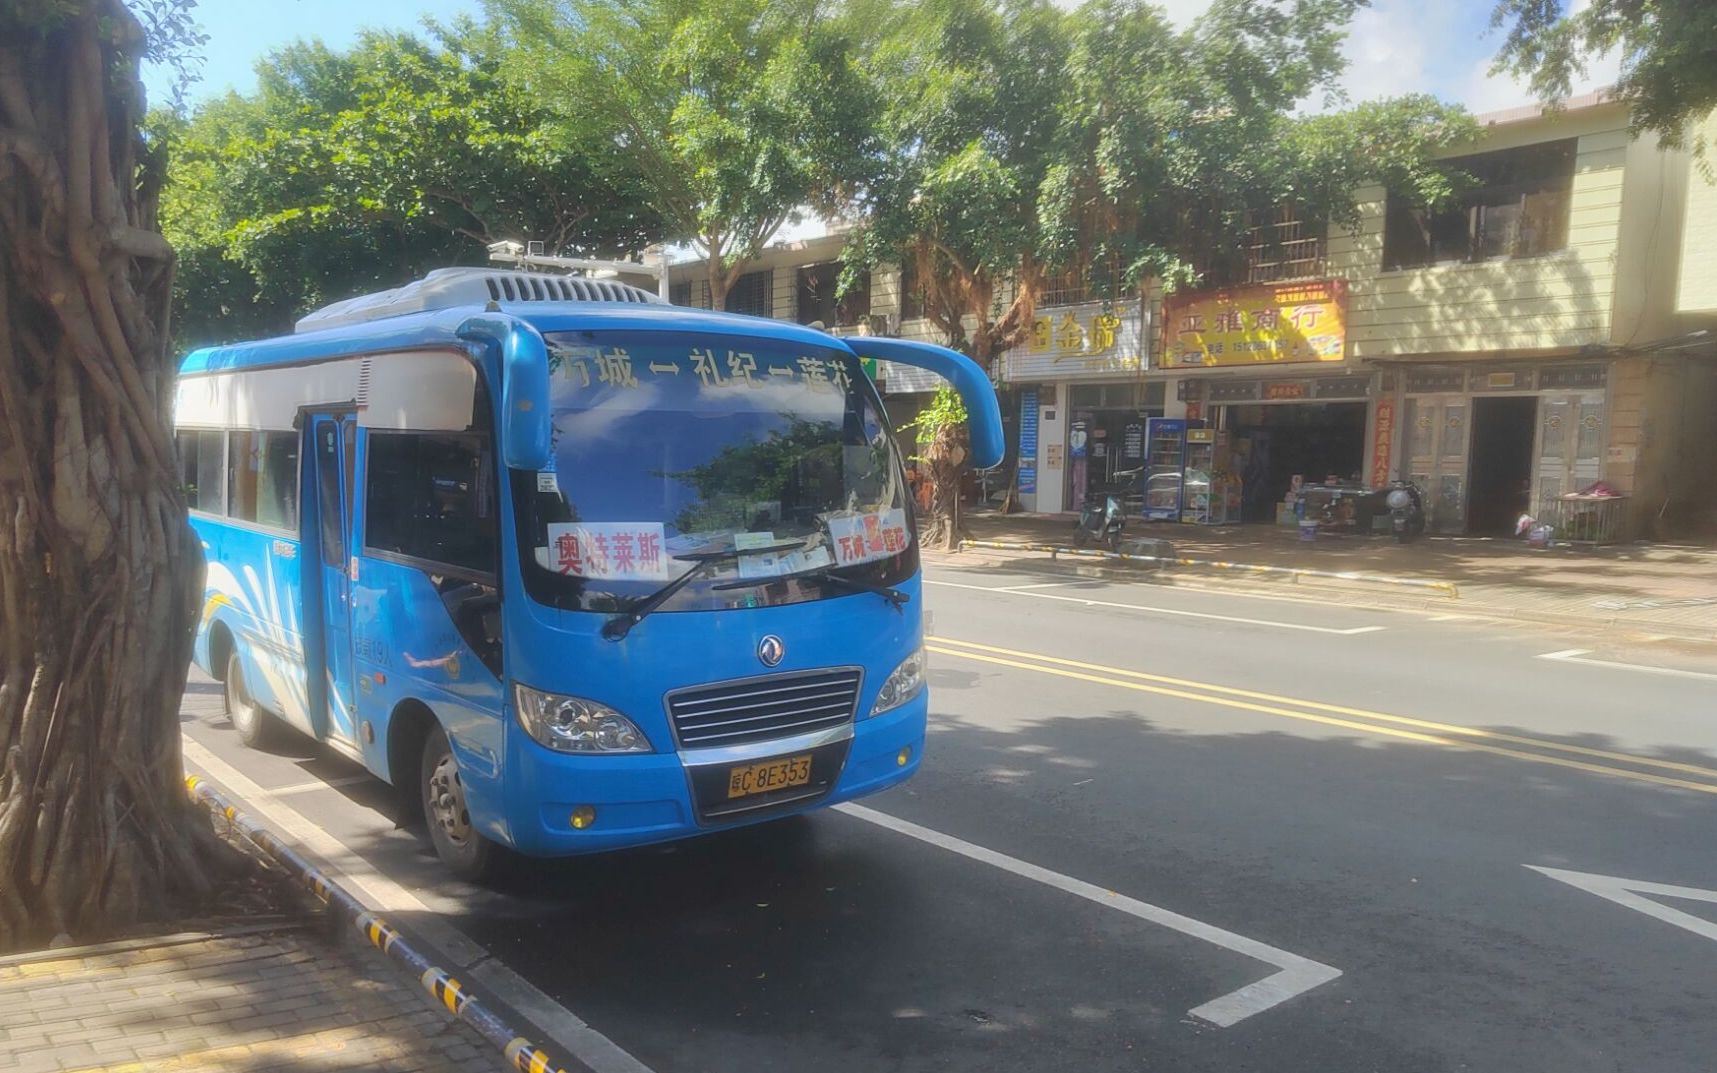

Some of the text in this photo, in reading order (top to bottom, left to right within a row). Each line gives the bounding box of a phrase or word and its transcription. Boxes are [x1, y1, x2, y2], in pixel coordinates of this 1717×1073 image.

[1178, 305, 1325, 335] 亚雅商行
[558, 347, 638, 388] 万城
[689, 348, 764, 389] 礼纪
[555, 532, 661, 576] 奥特莱斯
